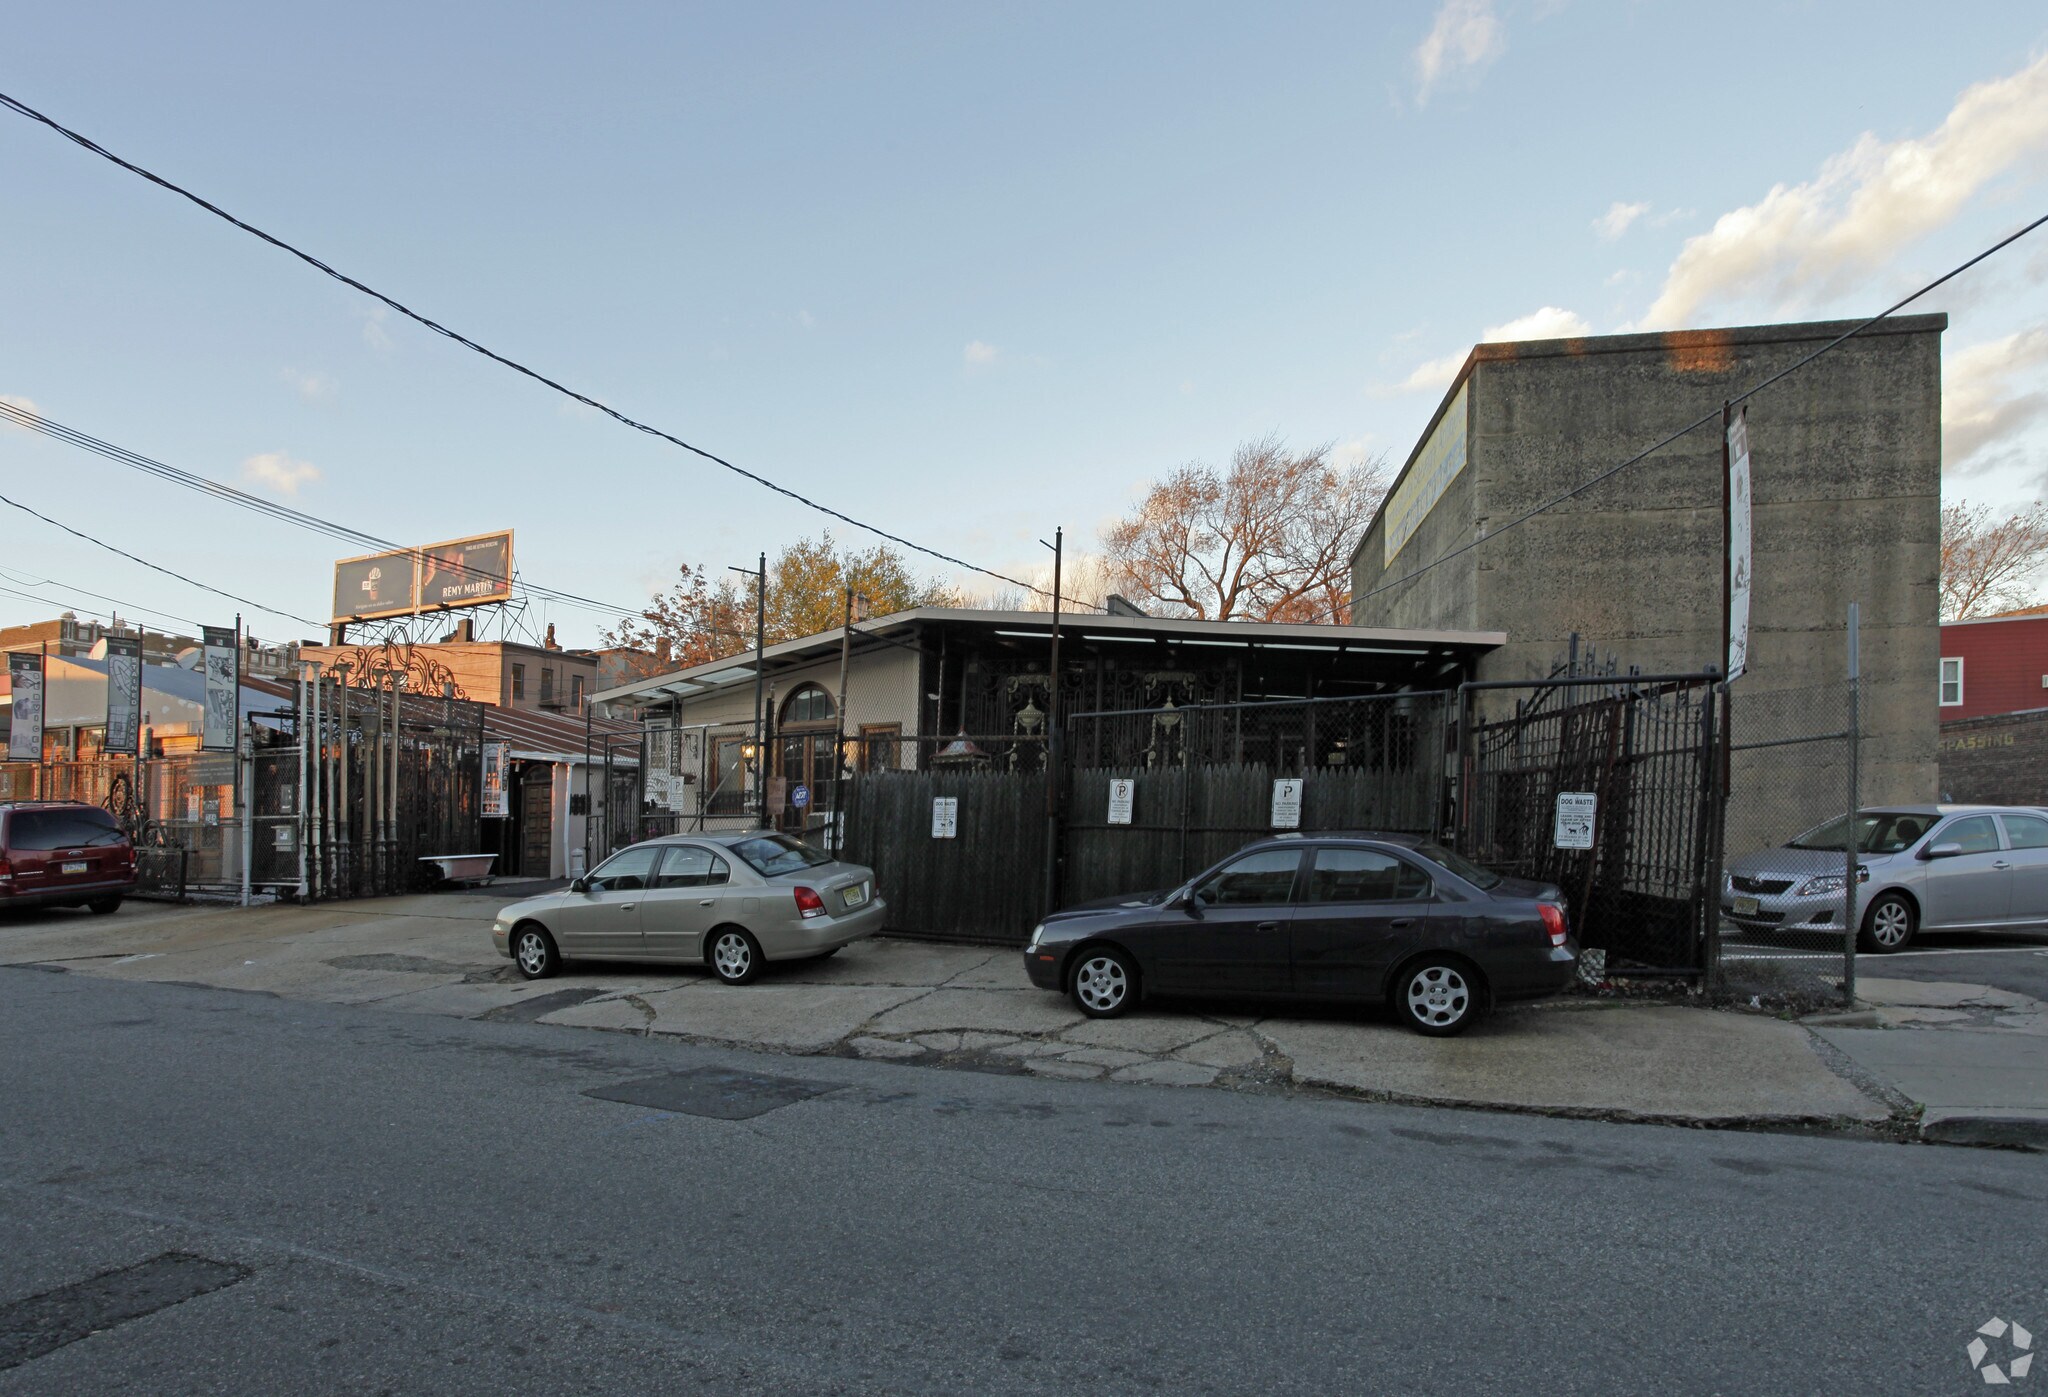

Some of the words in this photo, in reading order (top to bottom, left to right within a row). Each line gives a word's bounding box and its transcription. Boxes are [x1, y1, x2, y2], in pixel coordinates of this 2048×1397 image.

[464, 581, 493, 594] MARTIN
[32, 673, 40, 753] SERVICES
[128, 713, 137, 747] GLASS
[226, 693, 234, 744] PIECES
